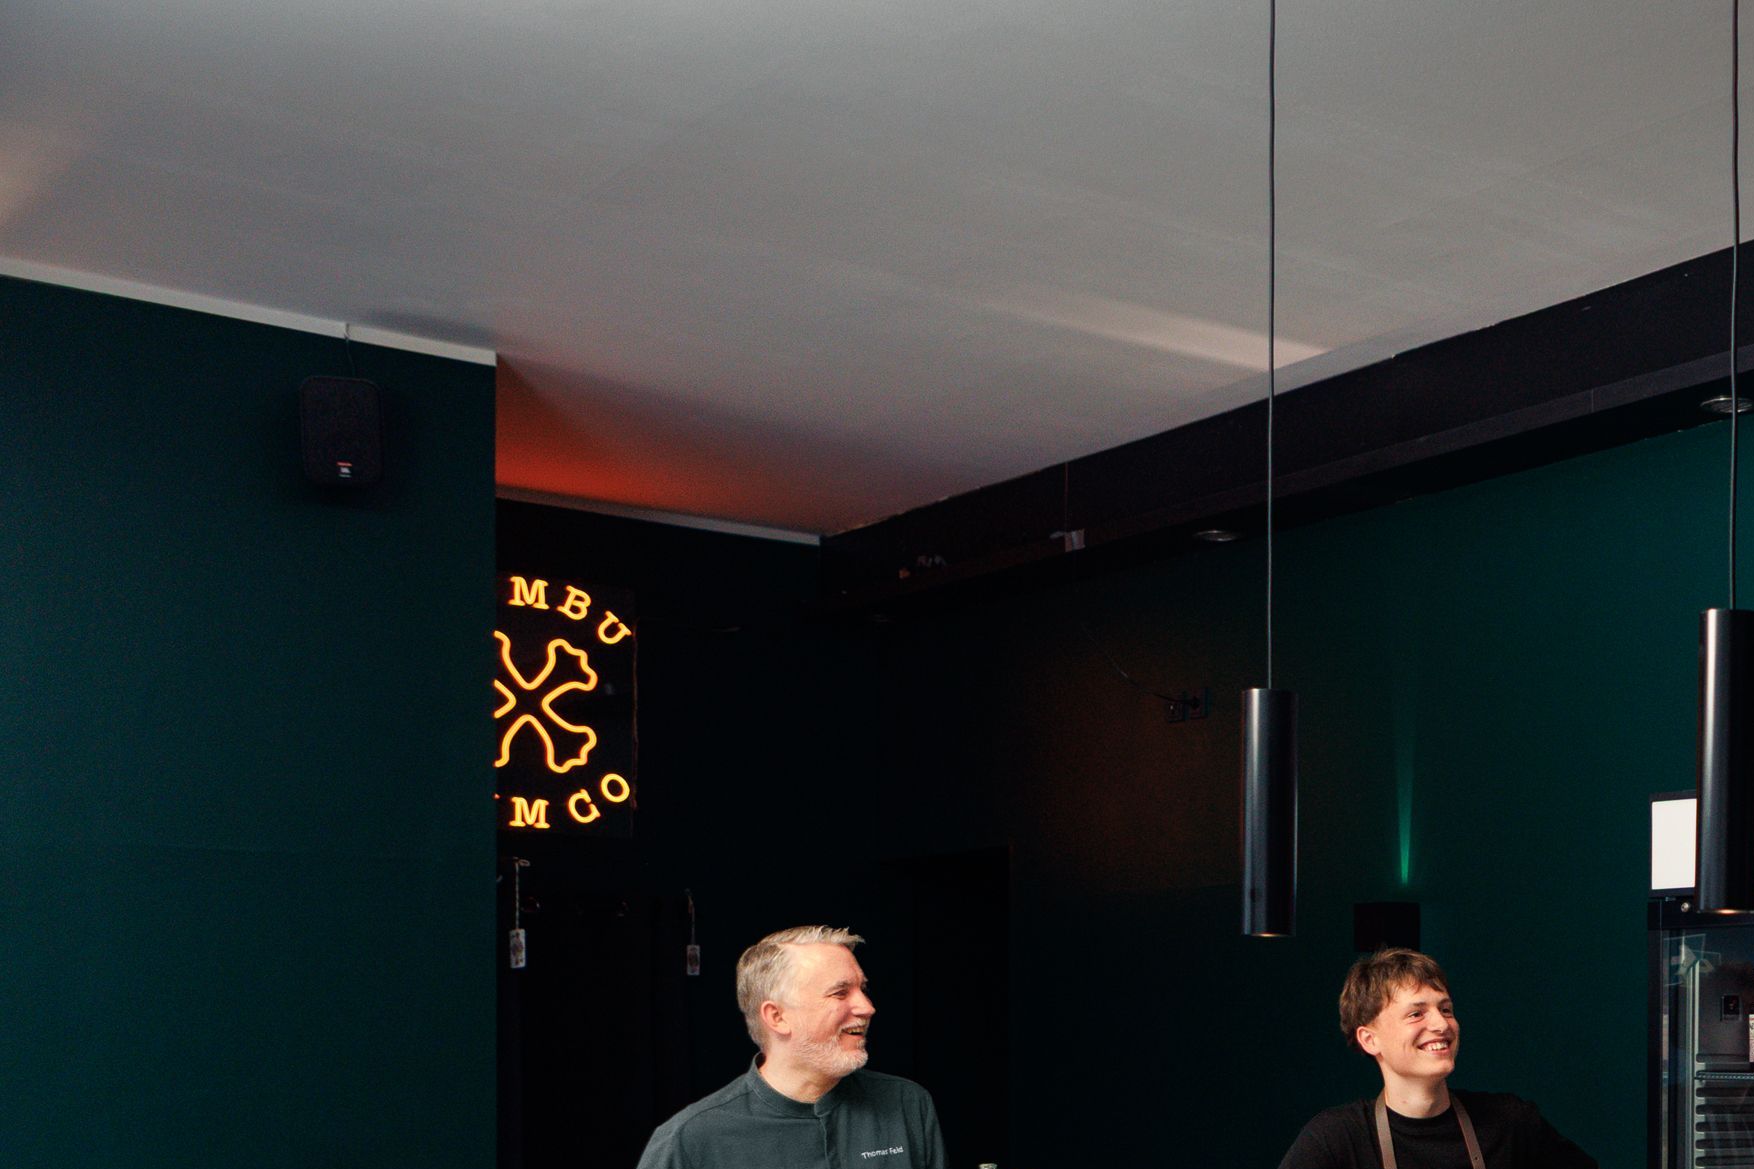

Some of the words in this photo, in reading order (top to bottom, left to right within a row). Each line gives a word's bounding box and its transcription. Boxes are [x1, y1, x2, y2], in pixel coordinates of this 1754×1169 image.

[508, 576, 632, 644] MBU
[568, 773, 631, 824] CO
[861, 1149, 888, 1160] Thomas
